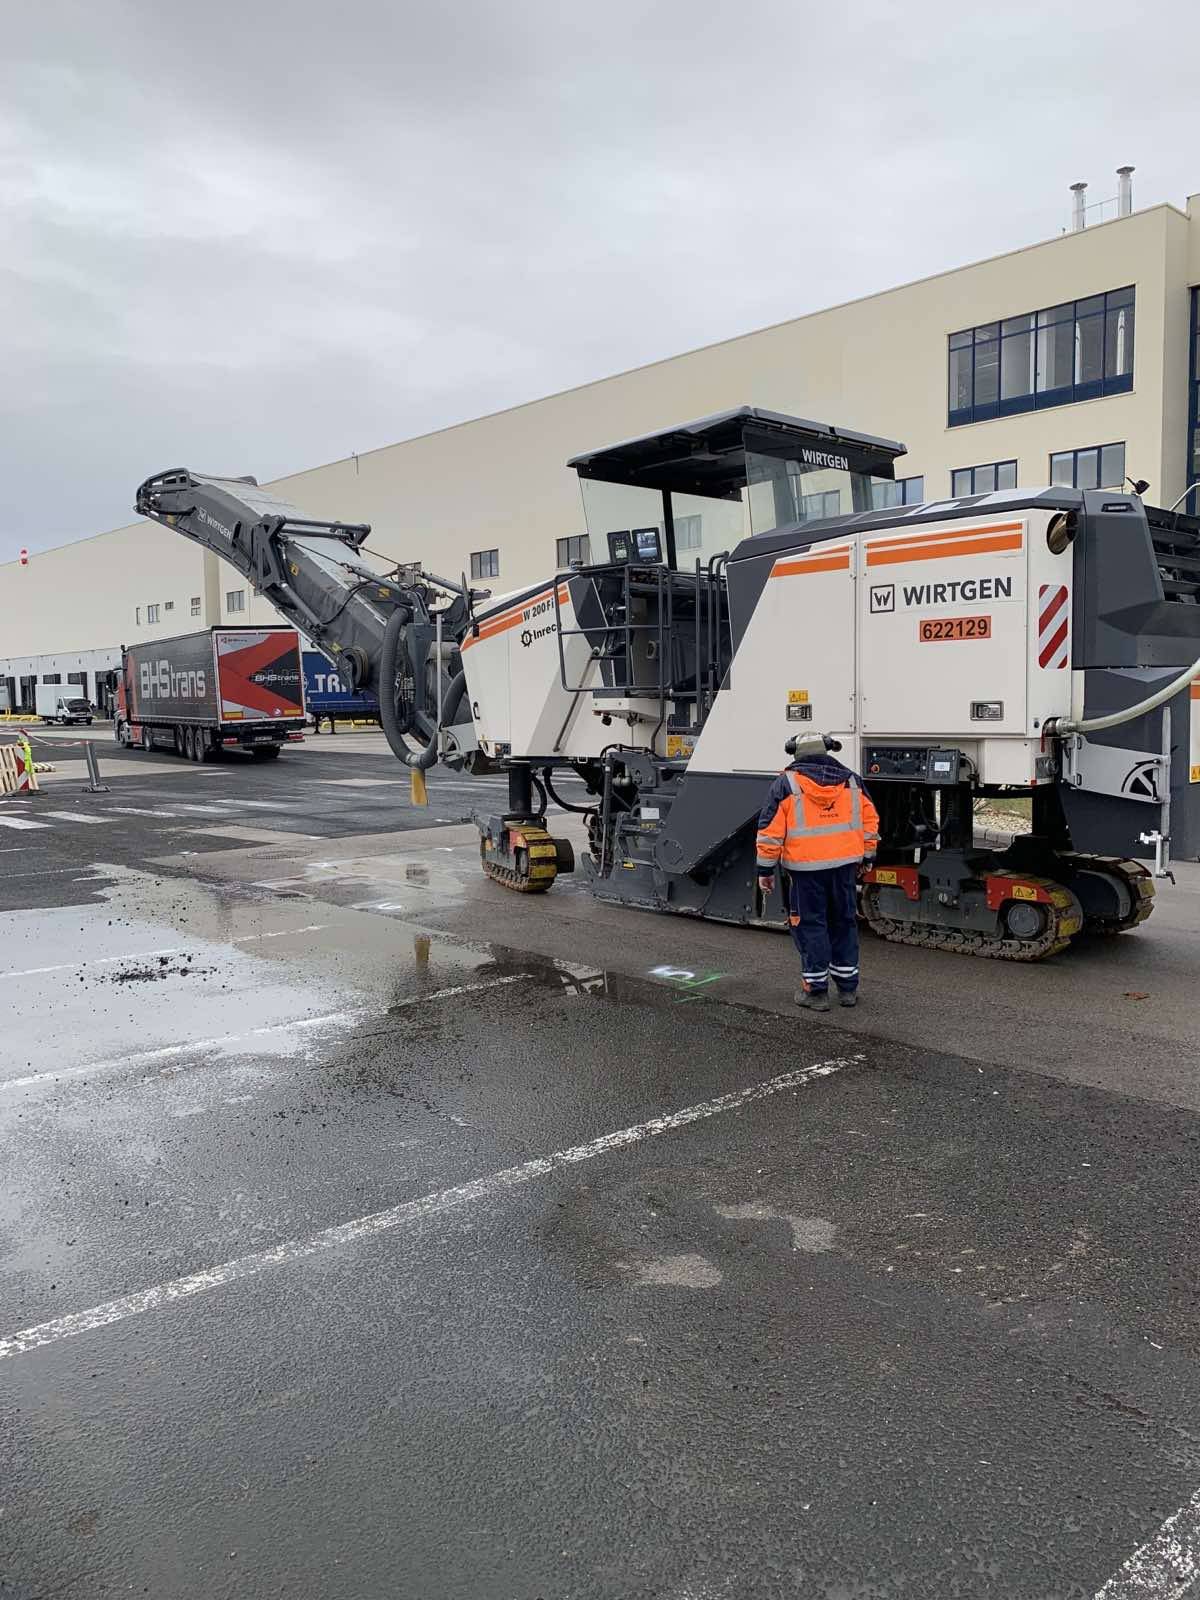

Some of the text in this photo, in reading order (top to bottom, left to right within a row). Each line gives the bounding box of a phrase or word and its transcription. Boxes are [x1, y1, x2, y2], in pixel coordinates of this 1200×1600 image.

[801, 448, 849, 470] WIRTGEN
[207, 514, 232, 540] WIRTGEN
[903, 576, 1012, 606] WIRTGEN
[523, 609, 531, 621] W
[532, 602, 546, 617] 200
[533, 623, 561, 640] Inrec
[922, 618, 988, 639] 622129
[140, 660, 206, 699] BHStrans
